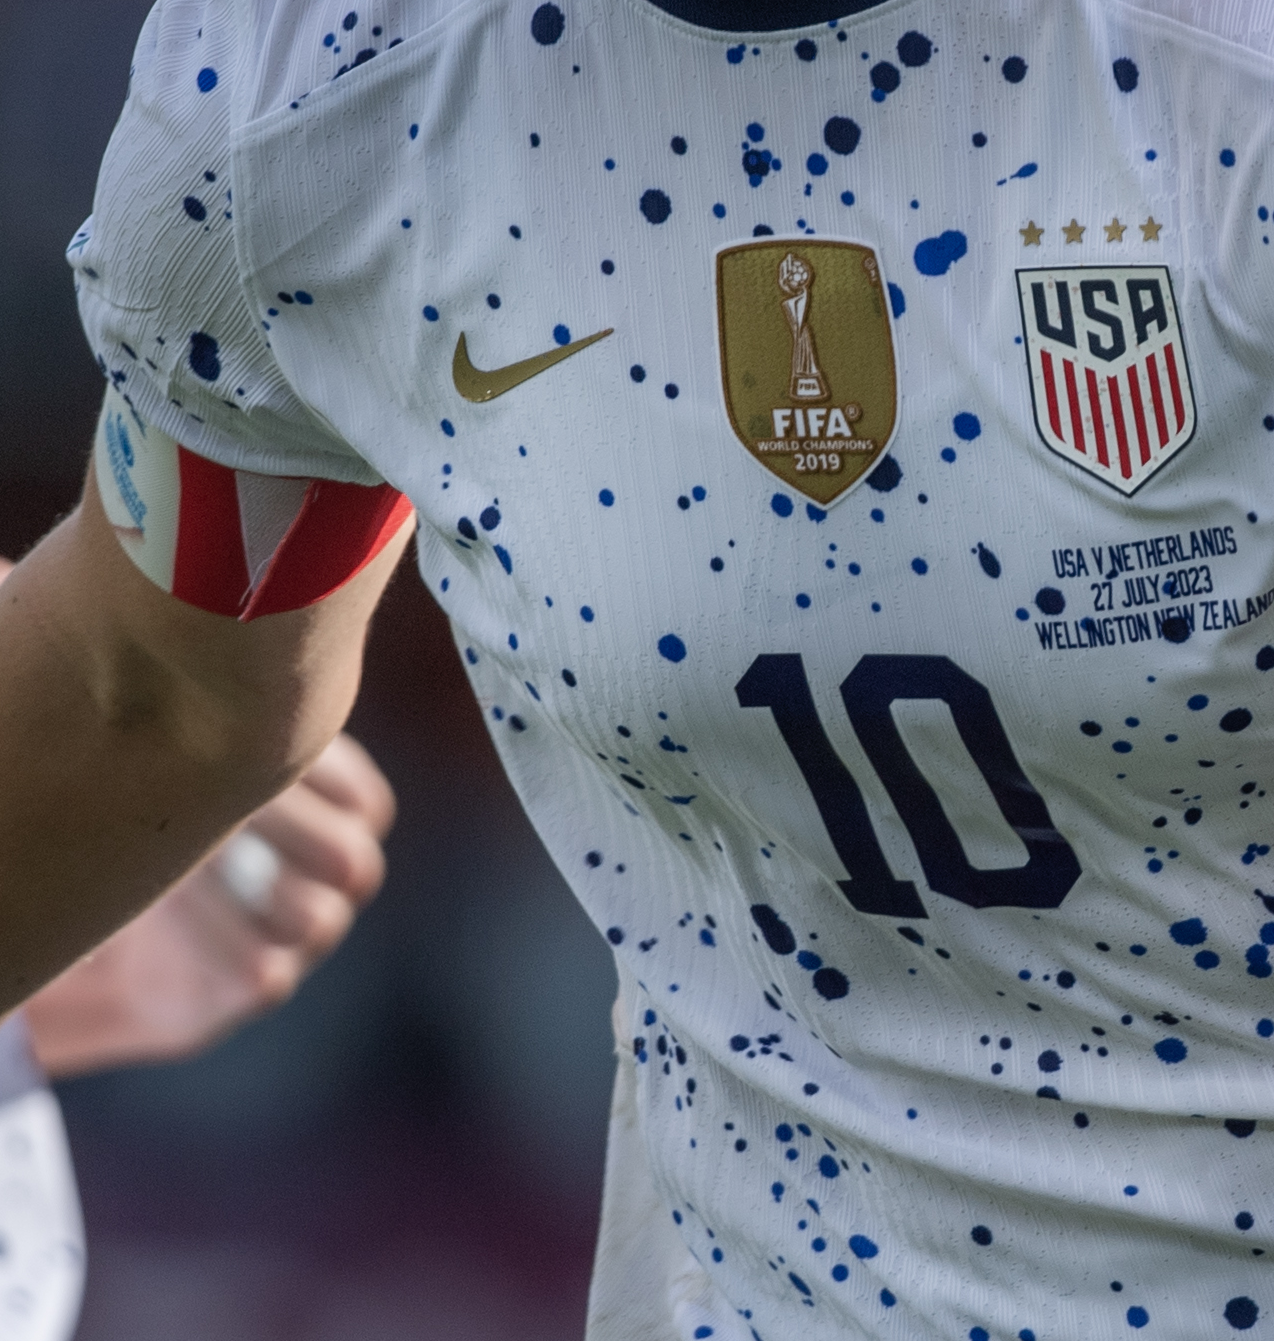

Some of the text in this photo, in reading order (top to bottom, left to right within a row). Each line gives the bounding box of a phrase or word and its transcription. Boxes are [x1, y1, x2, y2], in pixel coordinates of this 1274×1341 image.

[1031, 279, 1168, 362] USA
[772, 408, 852, 438] FIFA
[757, 439, 874, 451] WORLD CHAMPIONS
[794, 453, 841, 471] 2019
[1052, 526, 1237, 578] USA V NETHERLANDS
[1090, 564, 1213, 611] 27 JULY 2023
[1034, 610, 1152, 650] WELLINGTON
[734, 653, 1082, 919] 10
